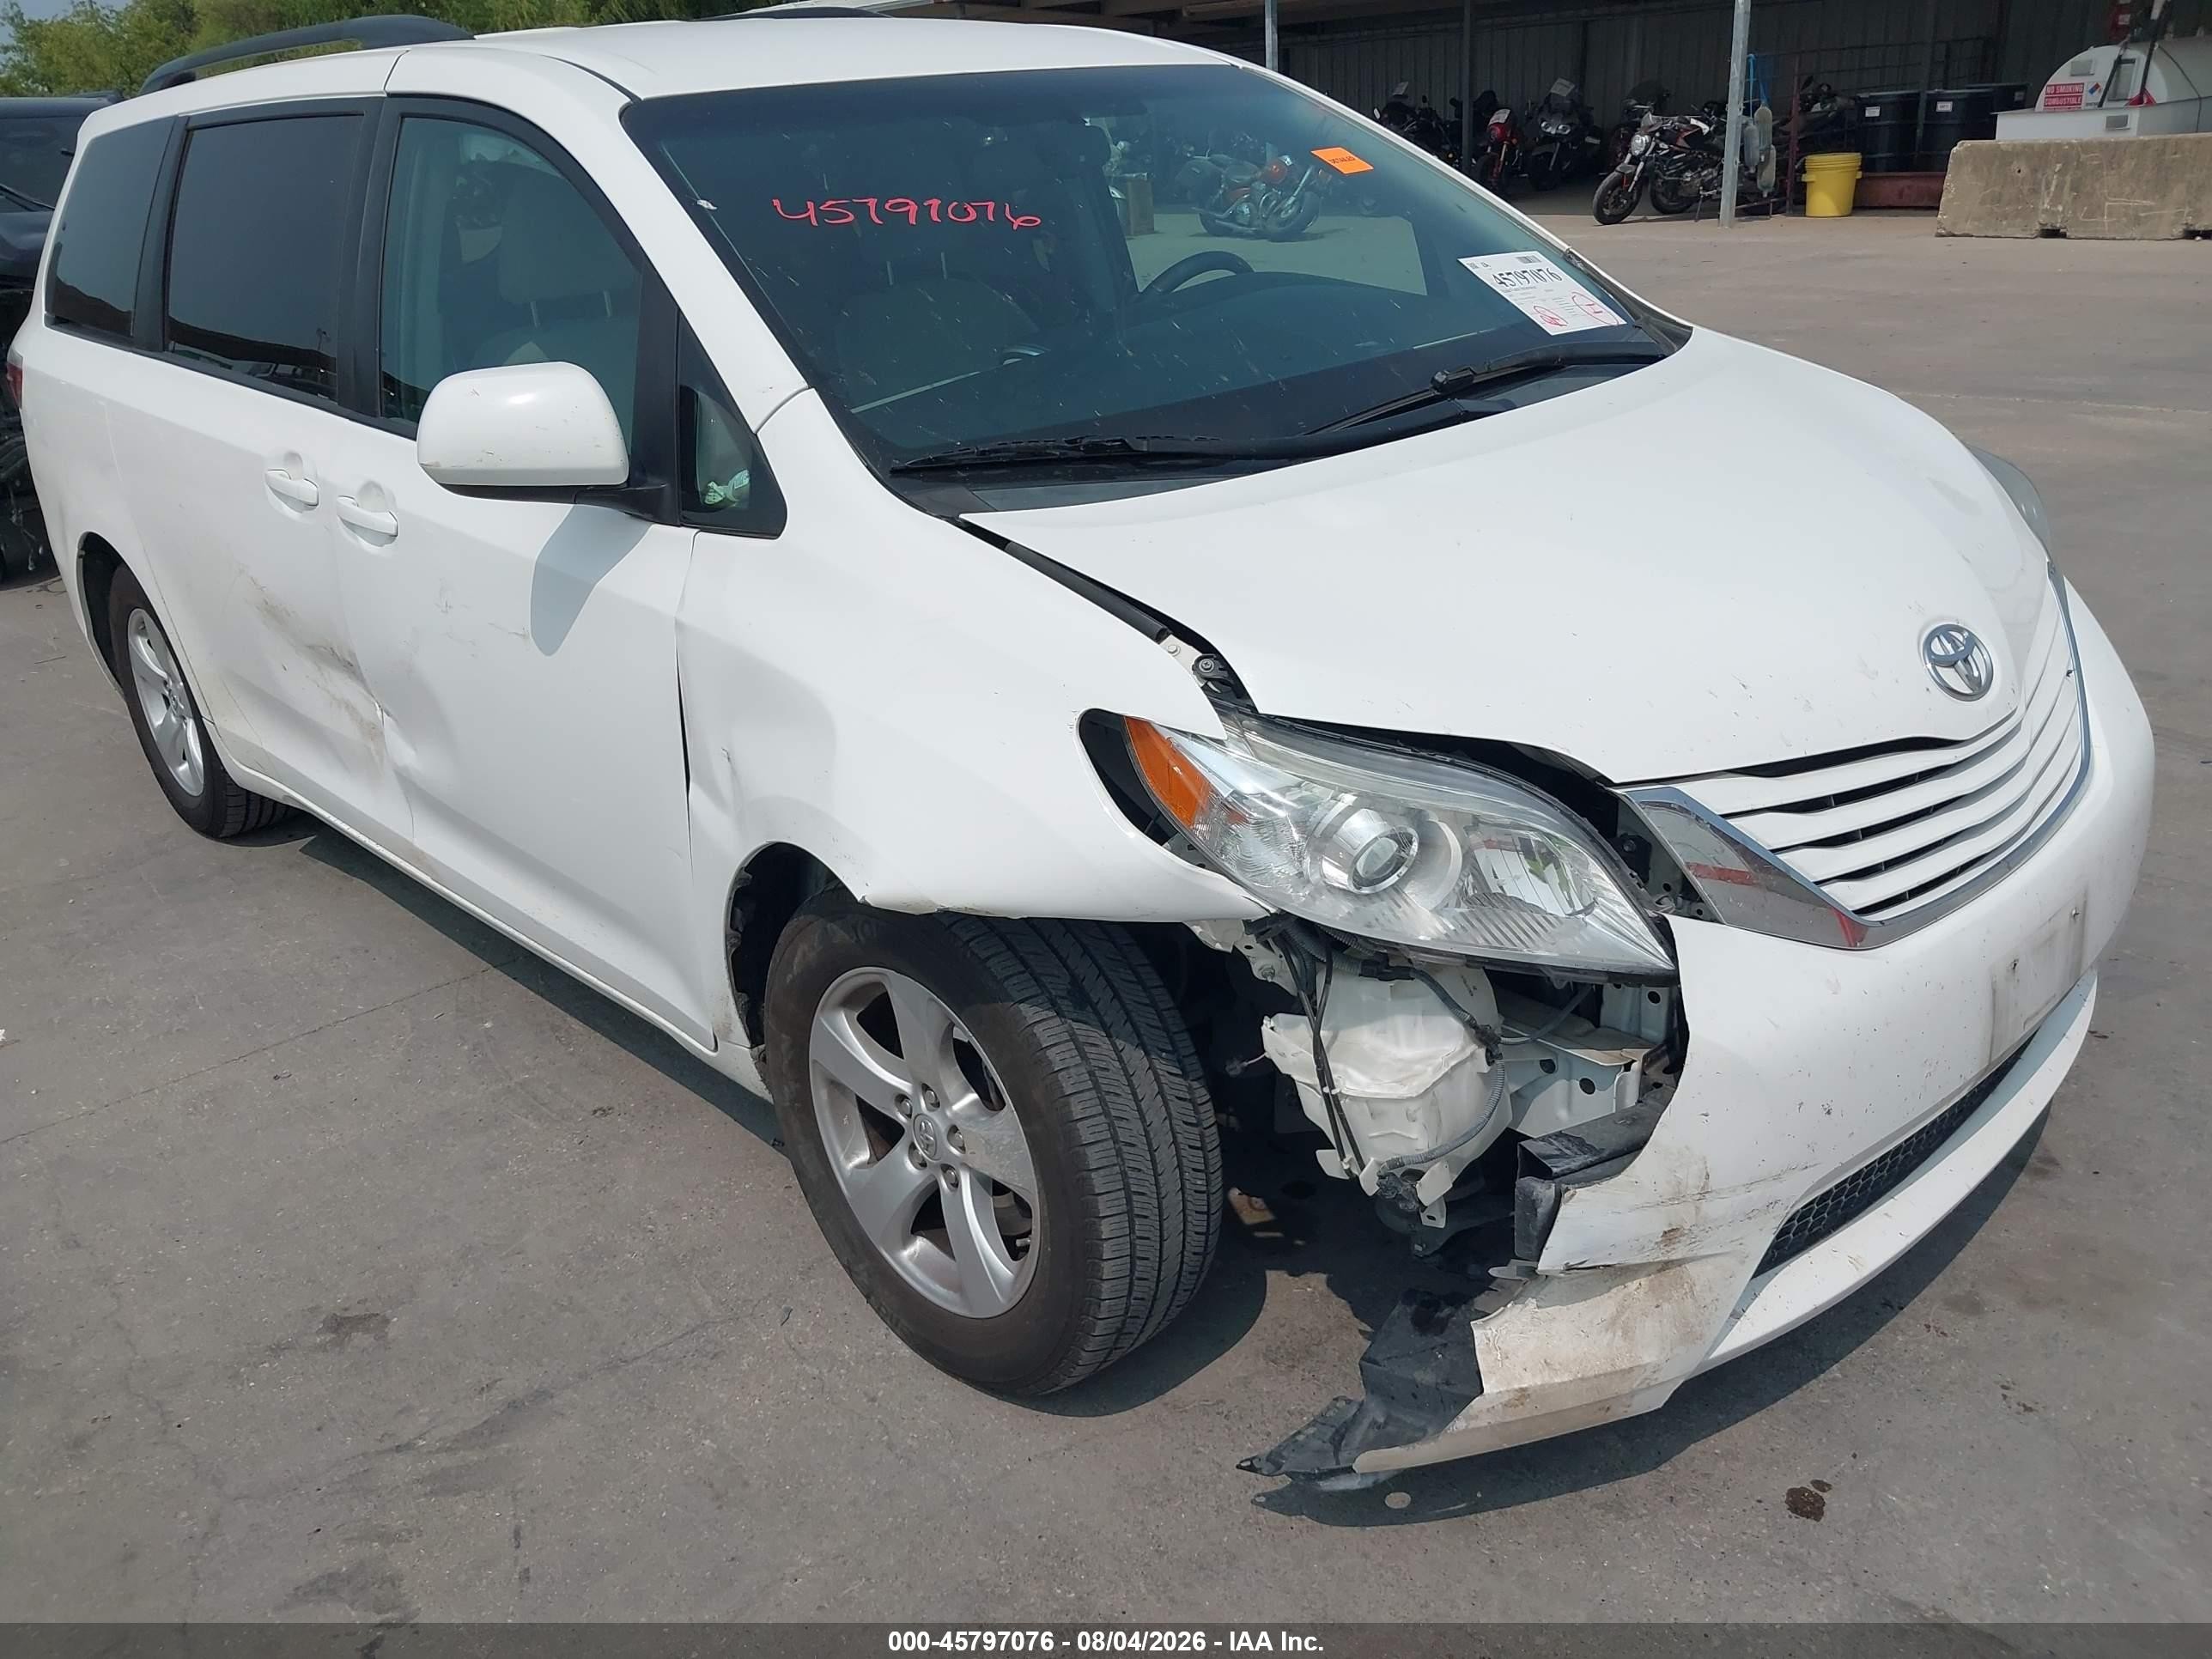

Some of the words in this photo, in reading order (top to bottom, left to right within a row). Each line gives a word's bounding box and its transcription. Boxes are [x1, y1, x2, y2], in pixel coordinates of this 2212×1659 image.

[2046, 85, 2055, 94] NO
[2056, 84, 2083, 93] SMOKING
[1492, 267, 1563, 288] 45797076
